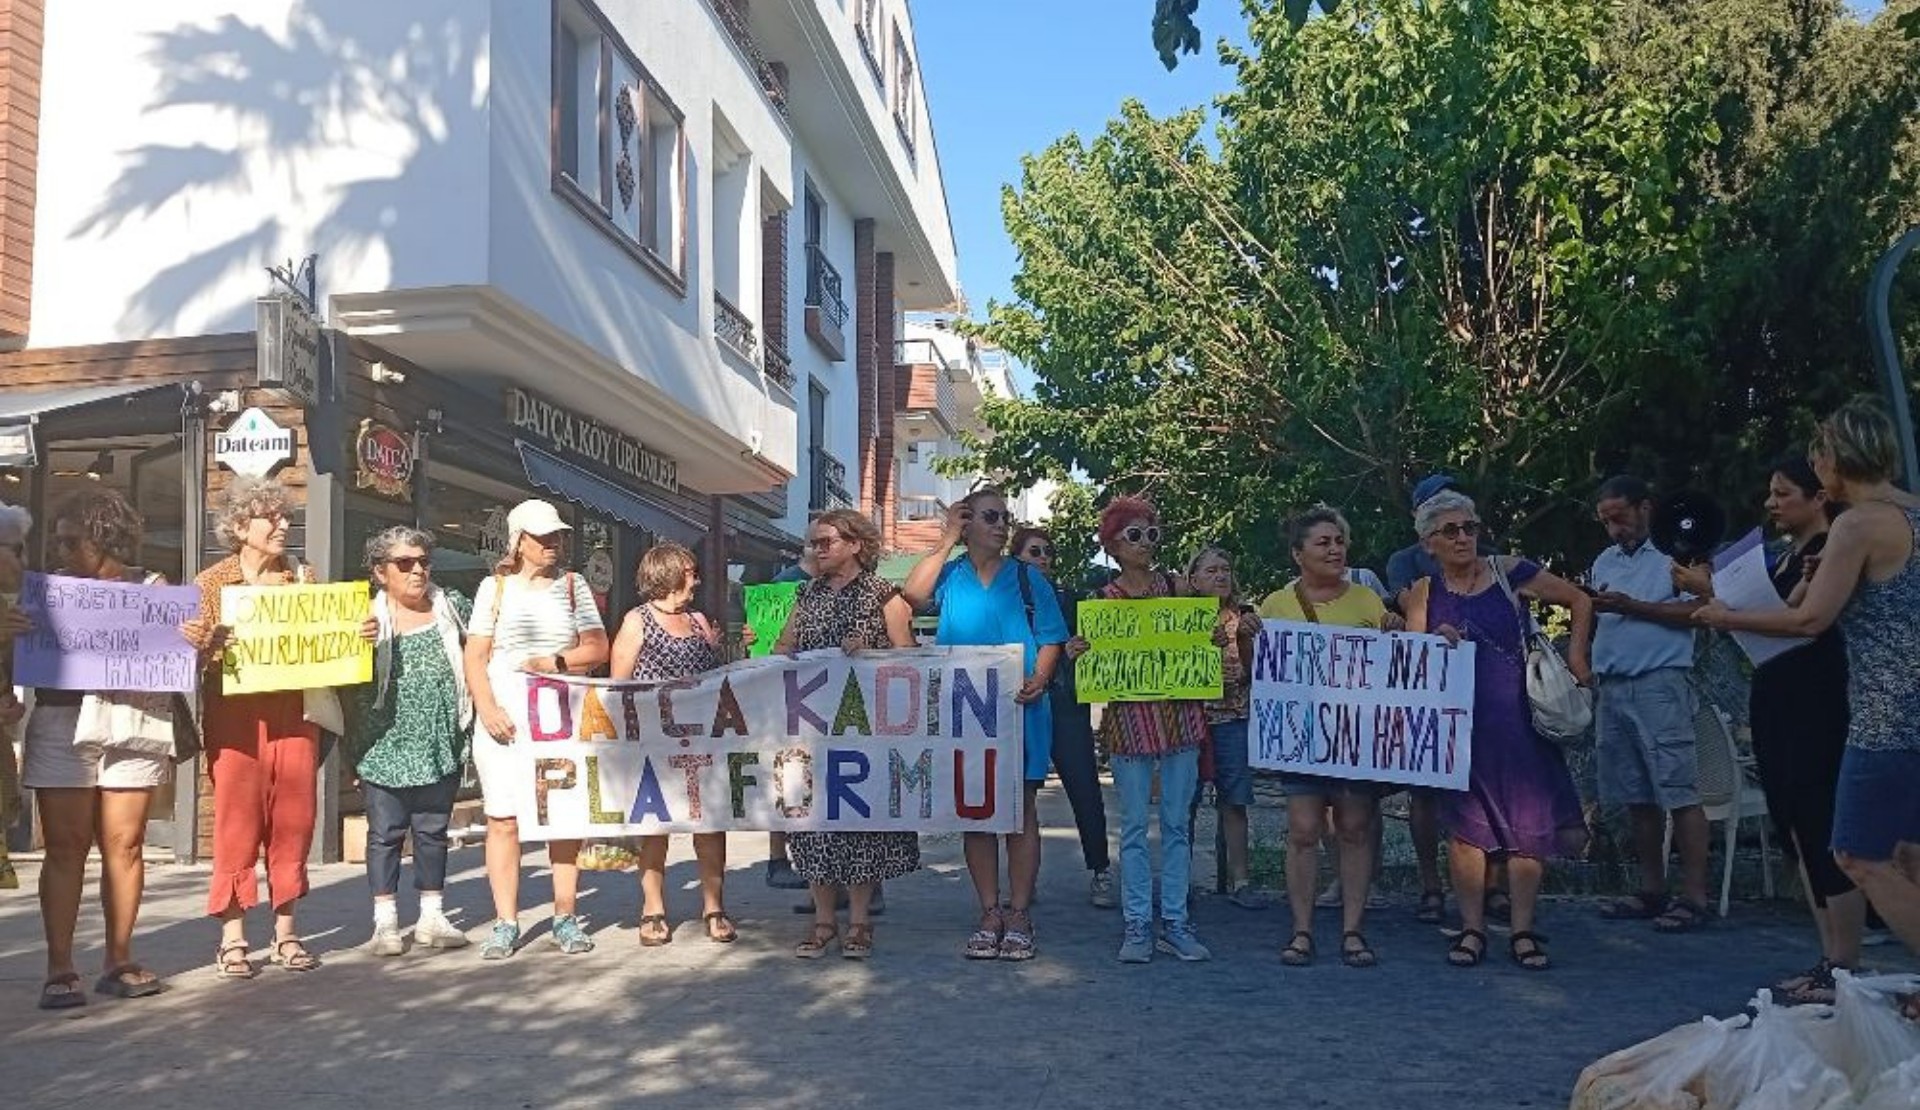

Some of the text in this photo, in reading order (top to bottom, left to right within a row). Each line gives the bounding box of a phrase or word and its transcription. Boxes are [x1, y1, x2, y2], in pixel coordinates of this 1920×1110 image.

[514, 388, 575, 451] DATÇA
[579, 419, 612, 467] KÖY
[27, 578, 141, 610] NEFRETE
[1255, 629, 1458, 692] NEFRETE İNAT
[526, 664, 999, 748] DATÇA KADIN
[1371, 703, 1468, 775] HAYAT
[534, 747, 999, 827] PLATFORMU
